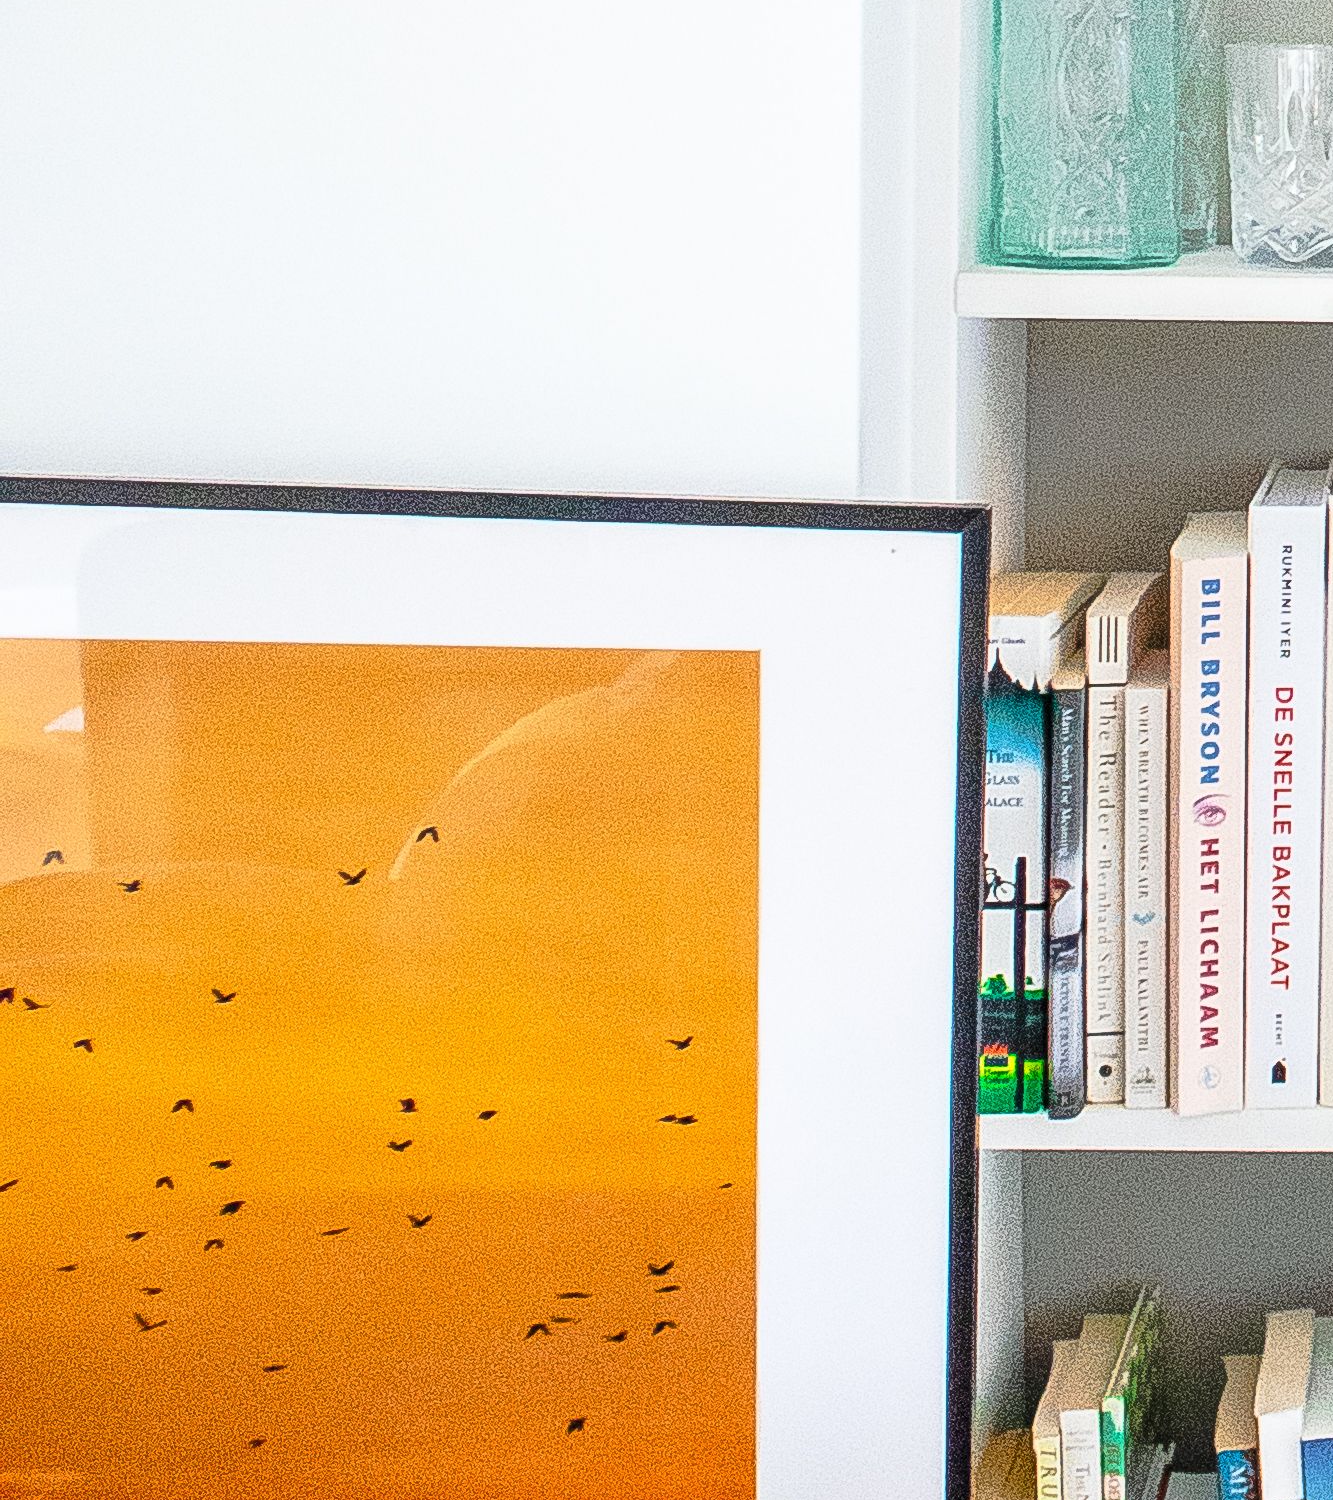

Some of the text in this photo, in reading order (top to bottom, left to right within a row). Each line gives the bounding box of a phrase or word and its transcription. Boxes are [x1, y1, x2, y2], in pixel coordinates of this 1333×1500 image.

[986, 798, 1025, 809] ALACE
[1098, 699, 1118, 833] The Reader
[1200, 578, 1222, 1050] BILL BRYSON HET LICHAAM
[1271, 545, 1295, 991] RUKMINI IYER DE SNELLE BAKPLAAT
